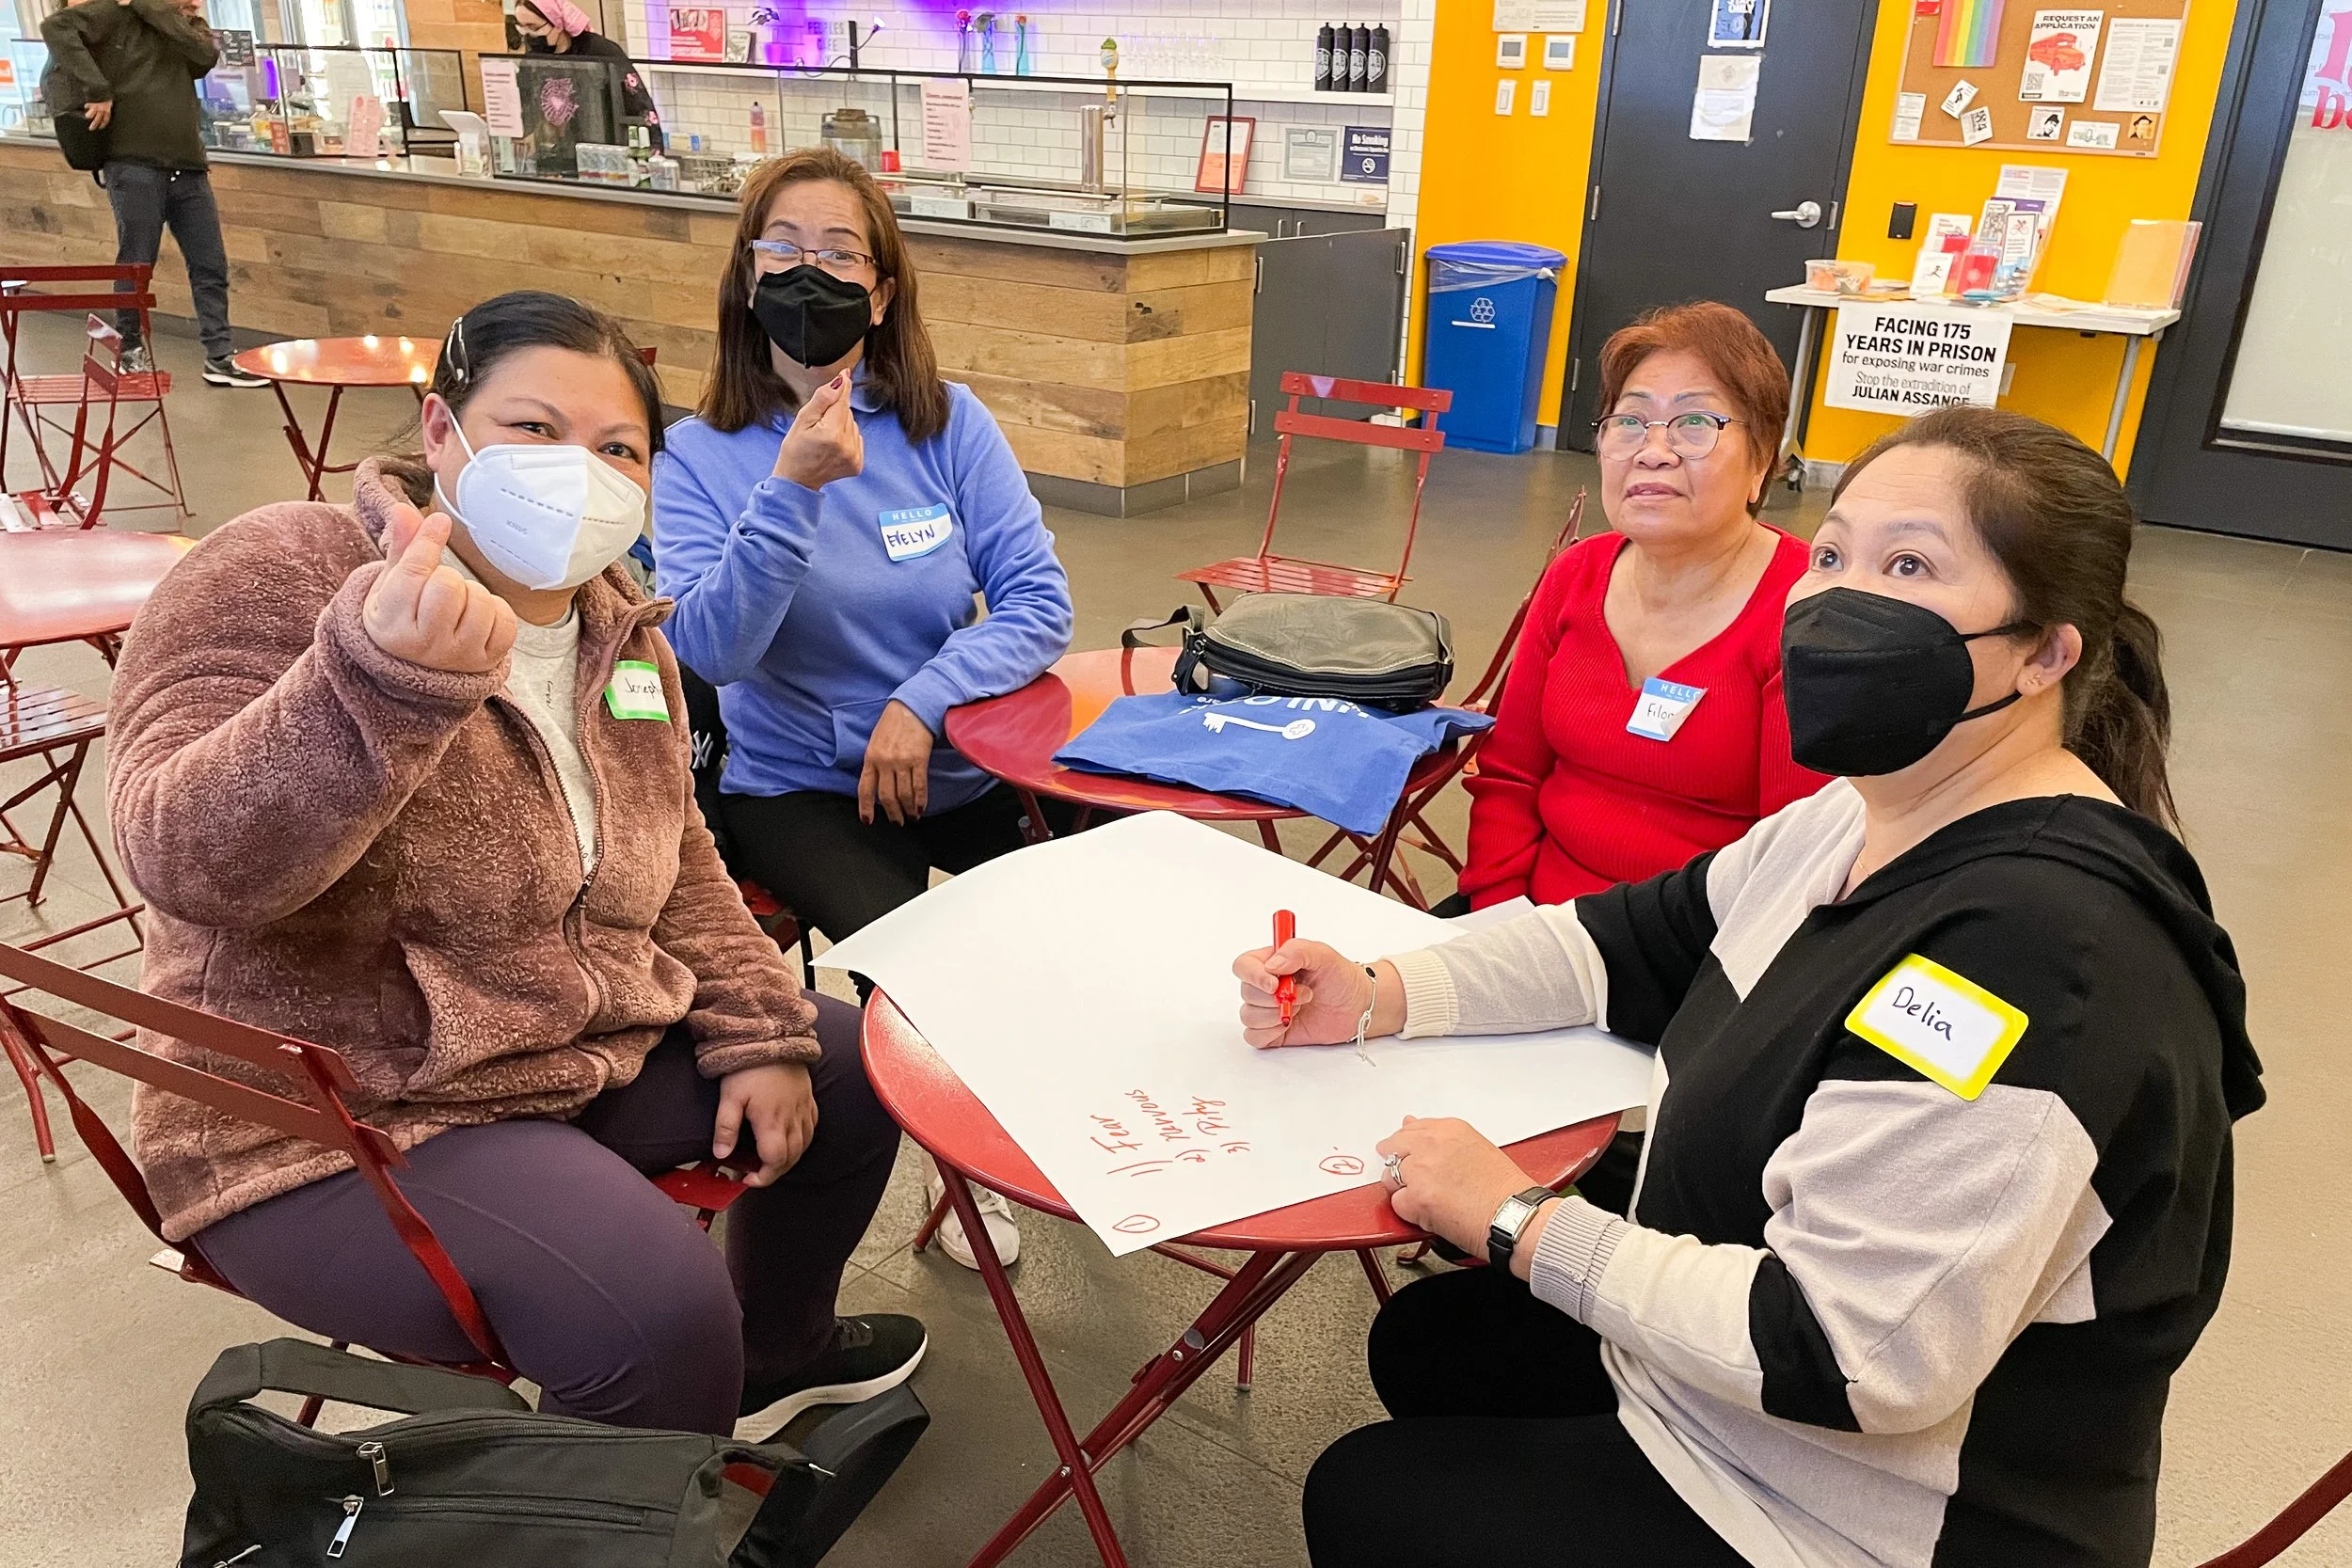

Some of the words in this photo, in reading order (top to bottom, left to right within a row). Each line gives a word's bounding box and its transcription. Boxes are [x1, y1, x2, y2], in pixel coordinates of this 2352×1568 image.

[1875, 316, 1938, 337] FACING
[1943, 323, 1972, 340] 175
[1846, 334, 1902, 354] YEARS
[1907, 340, 1925, 356] IN
[1928, 342, 1996, 362] PRISON
[1842, 351, 1860, 364] for
[1862, 356, 1915, 372] exposing
[1919, 361, 1944, 372] war
[1947, 363, 1990, 378] crimes
[1852, 386, 1899, 402] JULIAN
[1855, 371, 1880, 387] Stop
[1882, 373, 1899, 388] the
[1901, 377, 1957, 393] extradition
[1959, 382, 1972, 395] of
[892, 509, 932, 520] HELLO
[1892, 987, 1952, 1041] Delia
[1182, 1096, 1232, 1136] Pity
[1089, 1115, 1144, 1154] Fear
[1175, 1149, 1212, 1163] 2)
[1219, 1142, 1251, 1154] 3)
